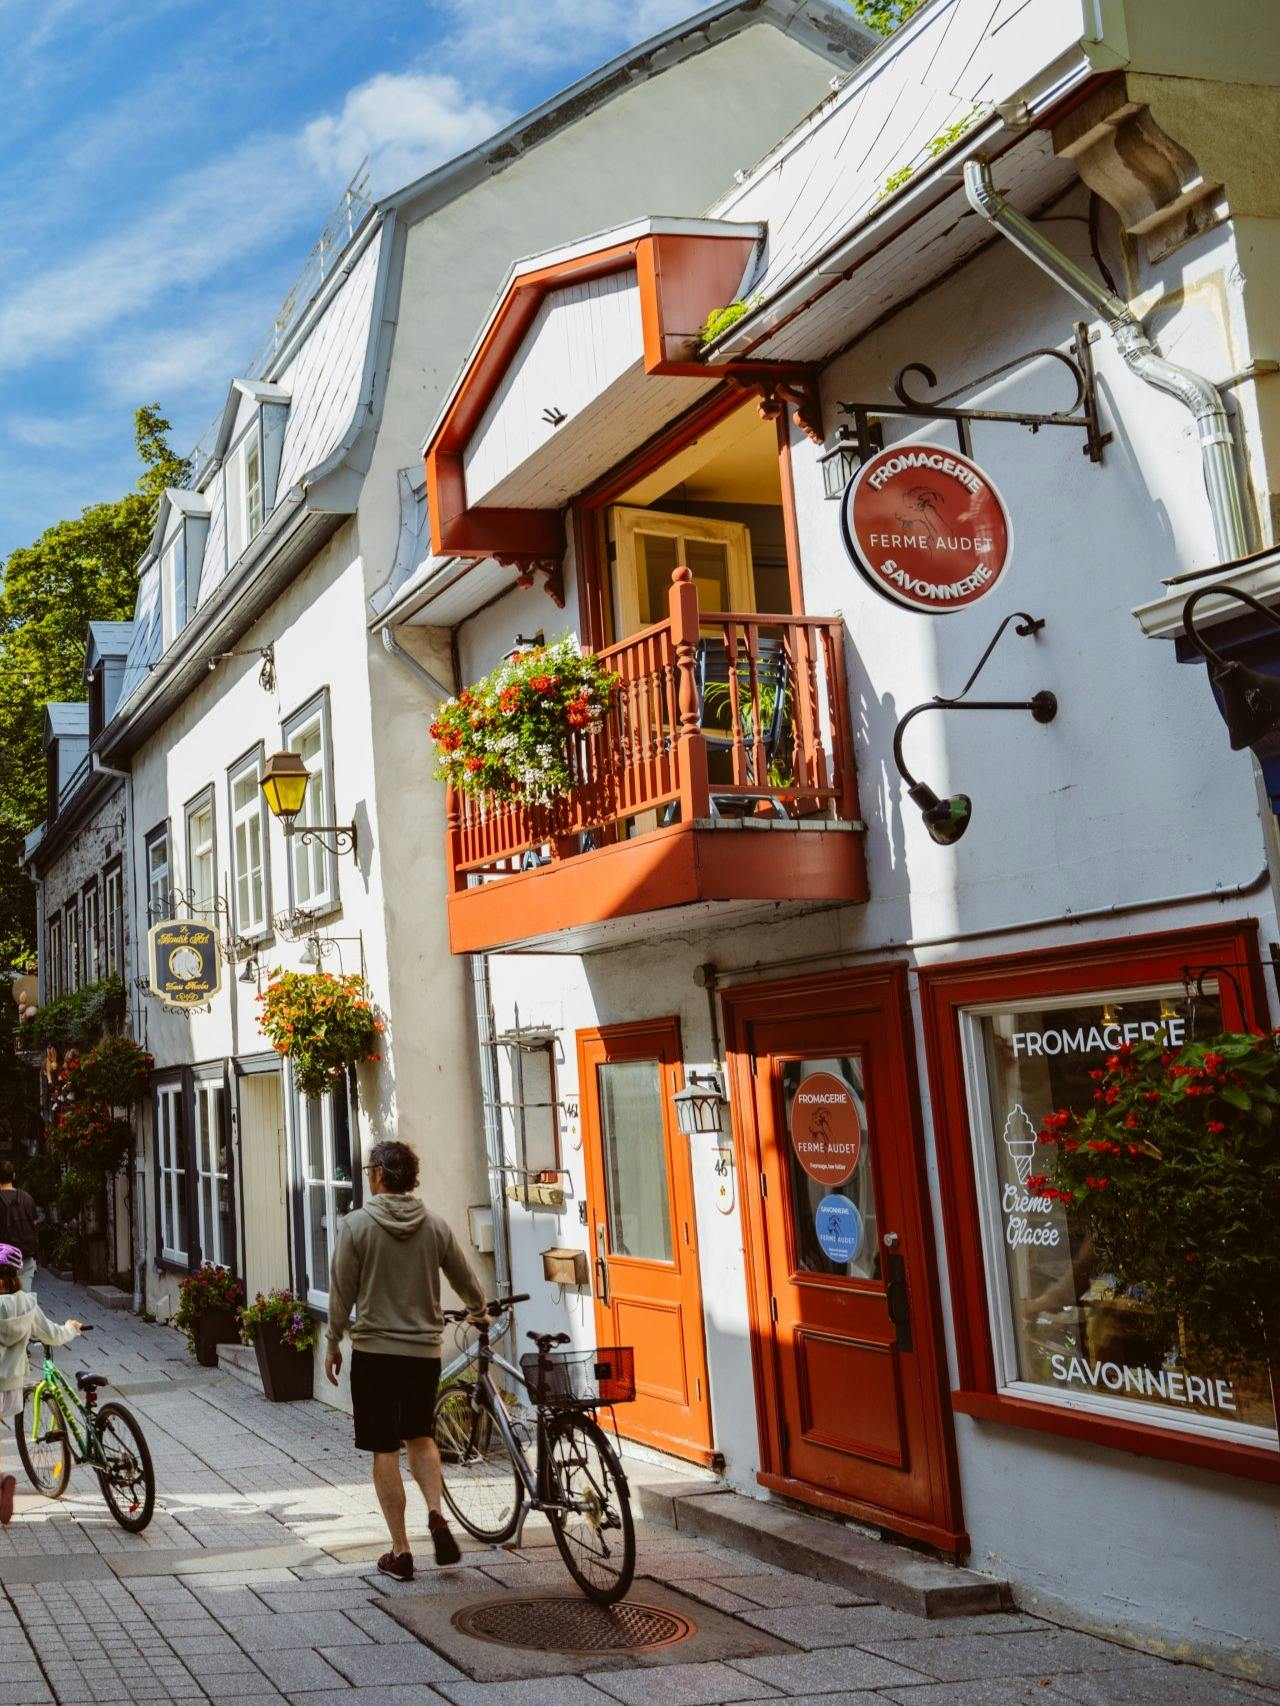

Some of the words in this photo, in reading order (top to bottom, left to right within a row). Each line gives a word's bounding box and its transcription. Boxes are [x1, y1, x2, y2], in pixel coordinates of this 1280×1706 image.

[868, 452, 983, 495] FROMAGERIE
[870, 534, 928, 549] FERME
[936, 537, 993, 552] AUDET
[881, 559, 993, 600] SAVONNERIE
[1011, 1018, 1186, 1058] FROMAGERIE
[798, 1094, 847, 1104] FROMAGERIE
[798, 1142, 825, 1153] FERME
[827, 1143, 856, 1154] AUDET
[714, 1159, 728, 1177] 46
[1002, 1183, 1053, 1213] Crème
[1006, 1214, 1060, 1250] Glacée
[1051, 1354, 1237, 1411] SAVONNERIE
